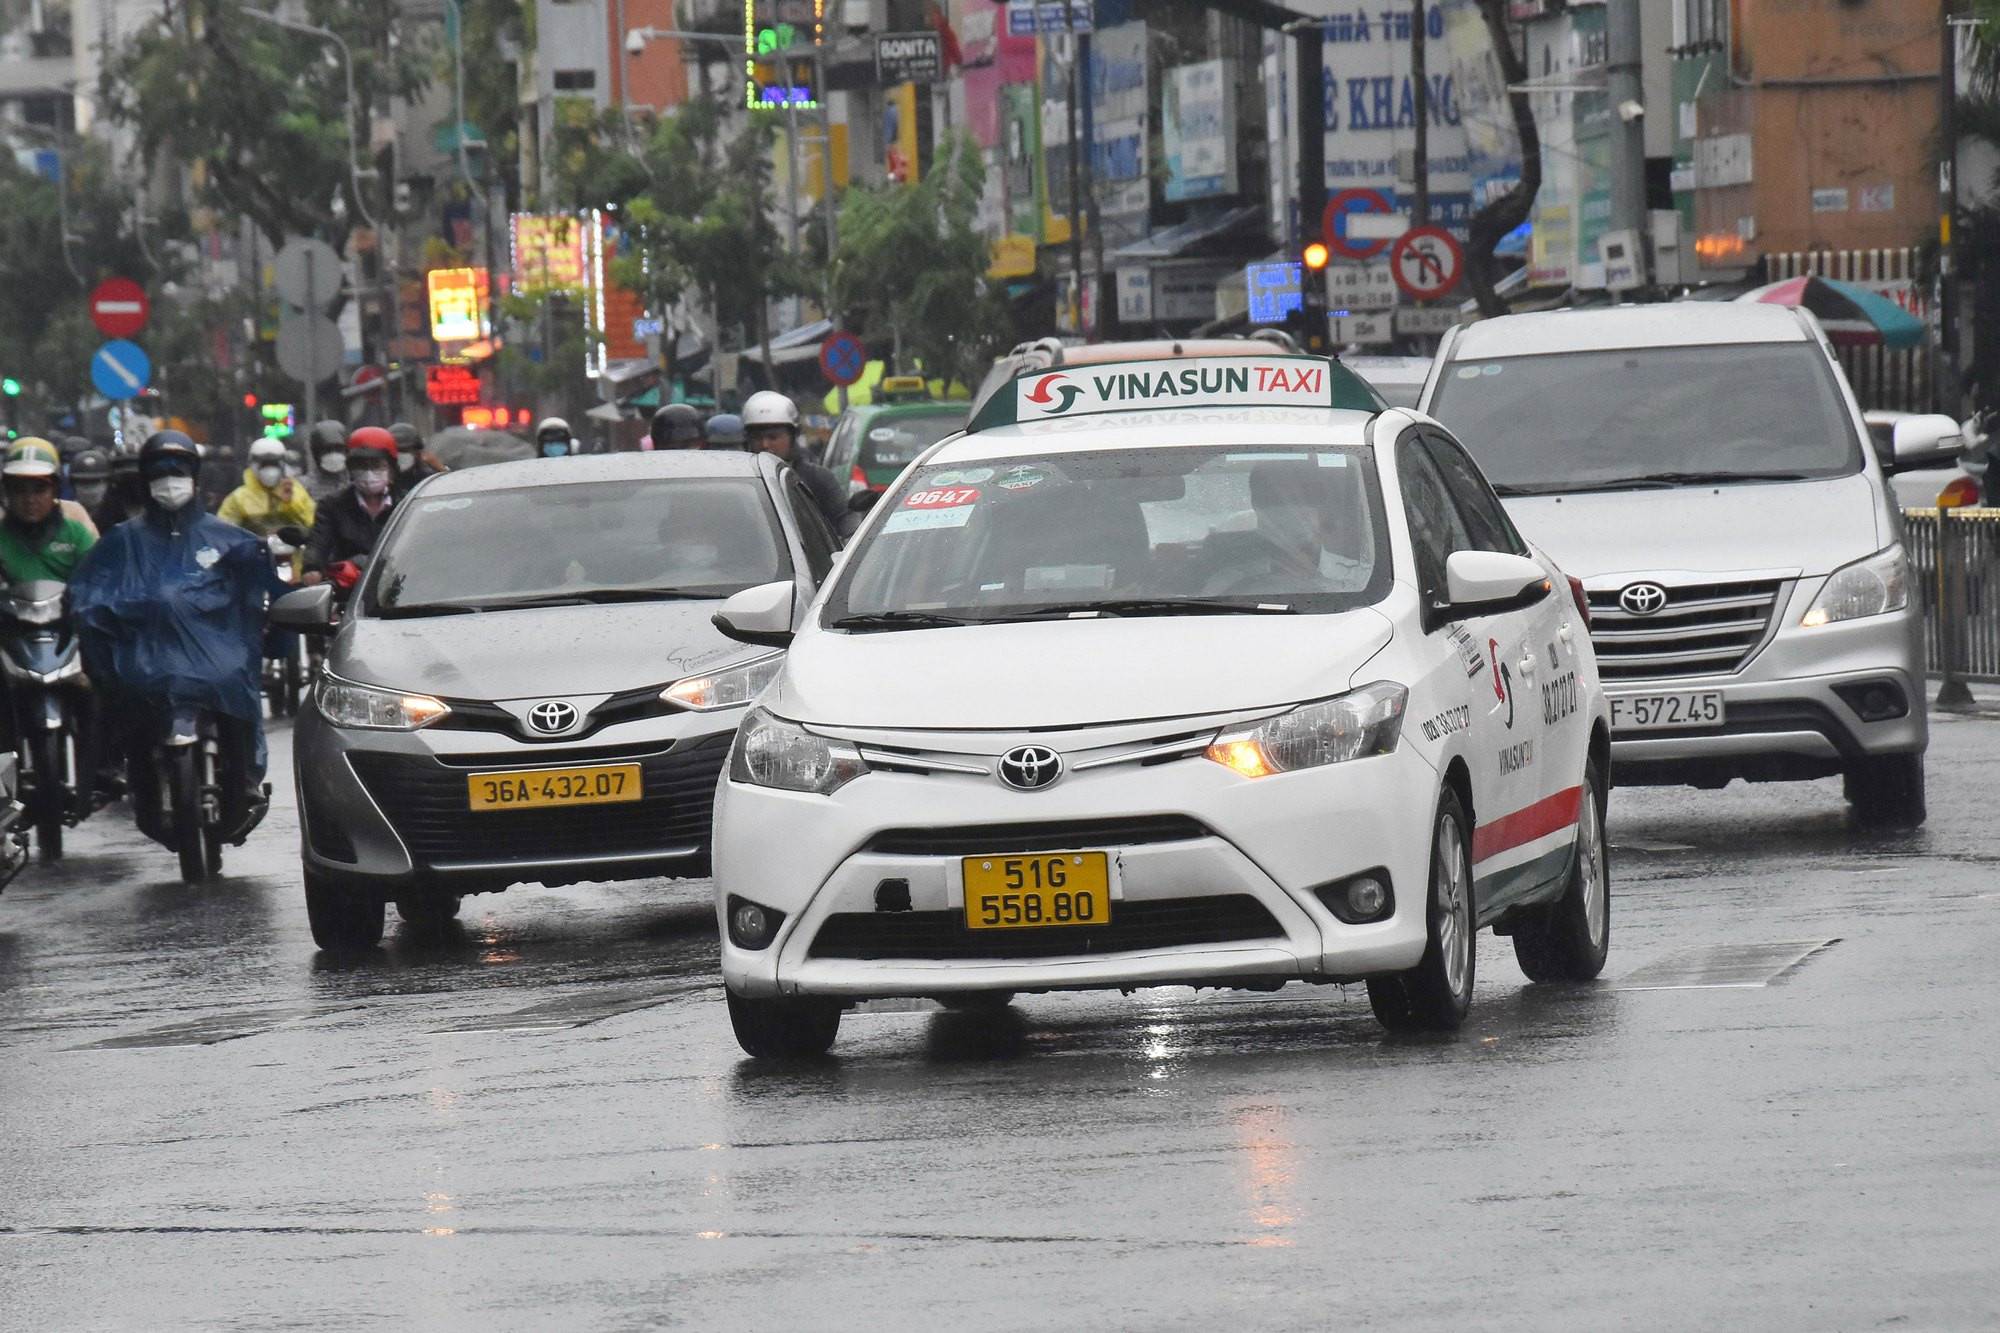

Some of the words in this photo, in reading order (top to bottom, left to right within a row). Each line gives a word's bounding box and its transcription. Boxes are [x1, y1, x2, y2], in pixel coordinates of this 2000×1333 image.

[880, 38, 936, 58] BONITA
[1347, 75, 1461, 129] KHANG
[1093, 367, 1248, 401] VINASUN
[1254, 367, 1322, 394] TAXI
[907, 489, 975, 506] 9647
[483, 772, 626, 803] 36A-432.07
[1004, 858, 1066, 889] 51G
[981, 891, 1093, 924] 558.80
